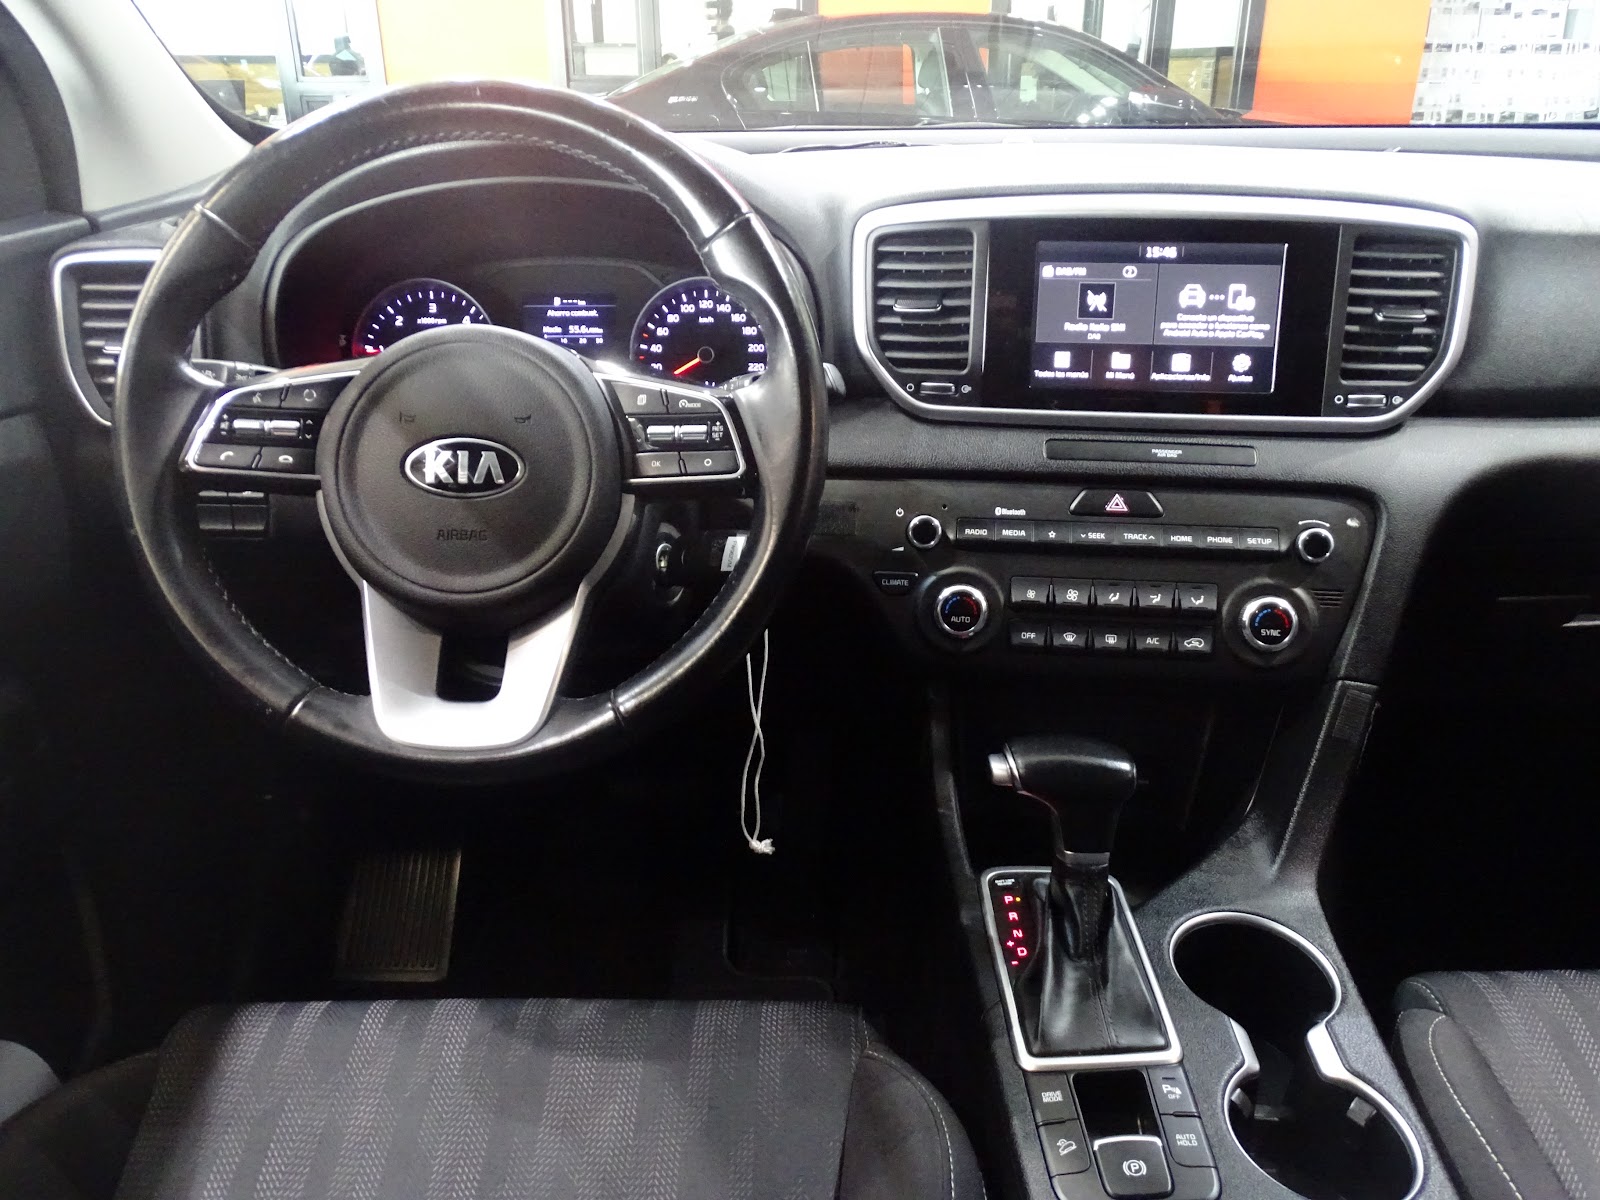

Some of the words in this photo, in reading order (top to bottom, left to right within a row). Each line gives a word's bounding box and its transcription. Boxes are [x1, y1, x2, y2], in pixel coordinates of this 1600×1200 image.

[429, 303, 437, 313] 3
[680, 304, 695, 312] 100
[699, 300, 713, 308] 120
[717, 304, 731, 312] 140
[395, 315, 403, 326] 2
[462, 315, 471, 324] 4
[667, 314, 679, 323] 80
[731, 314, 746, 322] 160
[656, 327, 669, 336] 60
[742, 326, 757, 335] 180
[650, 344, 662, 352] 40
[748, 344, 765, 352] 200
[748, 363, 765, 372] 220
[424, 450, 505, 484] KIA
[1002, 508, 1026, 516] Bluetooth
[436, 530, 488, 541] AIRBAG
[882, 578, 909, 586] CLIMATE
[1261, 629, 1281, 637] SYNC
[1004, 895, 1014, 904] P
[1008, 912, 1018, 921] R
[1012, 930, 1023, 938] N
[1017, 947, 1027, 956] D
